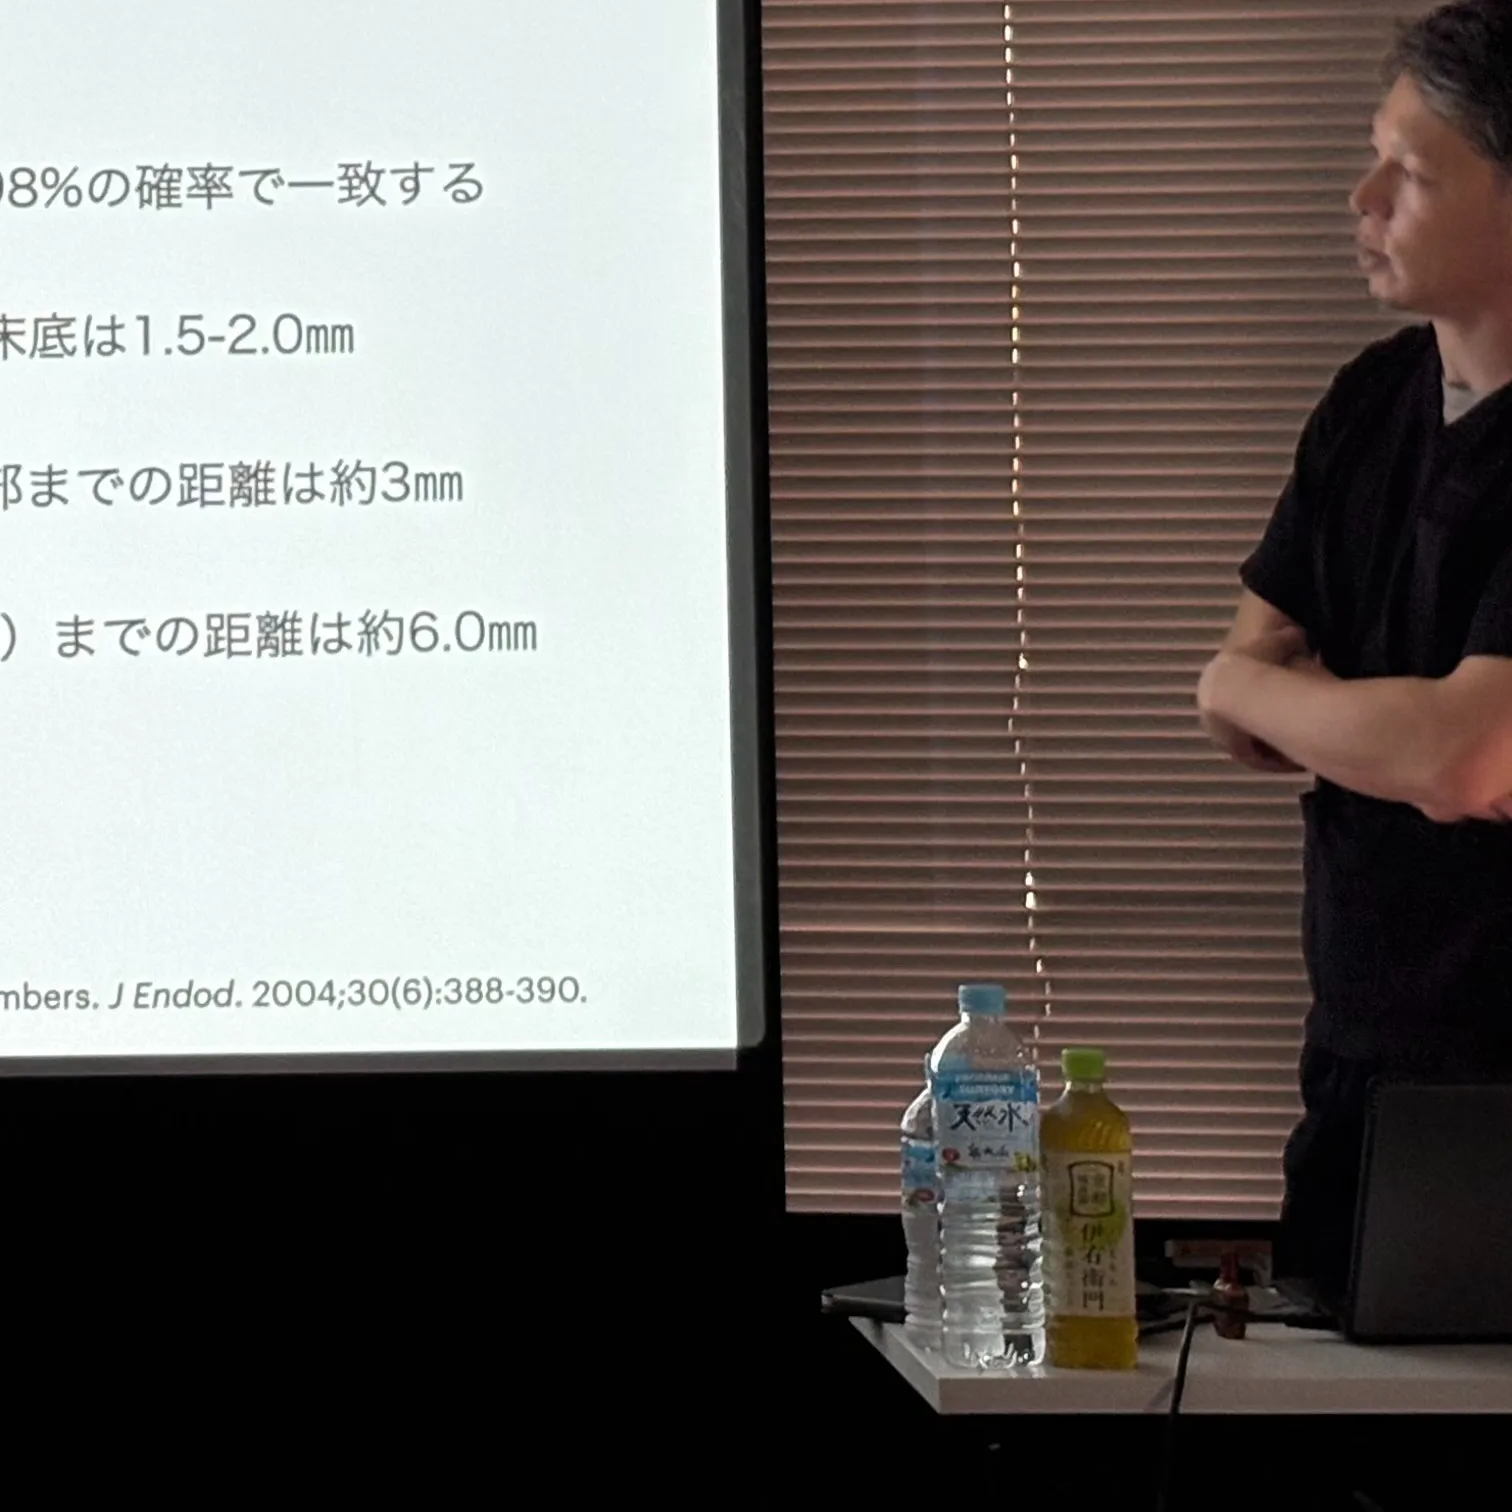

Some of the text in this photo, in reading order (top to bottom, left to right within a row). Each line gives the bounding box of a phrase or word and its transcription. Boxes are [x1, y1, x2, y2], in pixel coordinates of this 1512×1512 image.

[107, 982, 124, 1010] J
[133, 978, 243, 1009] Endod.
[252, 975, 587, 1011] 2004;30(6):388-390.
